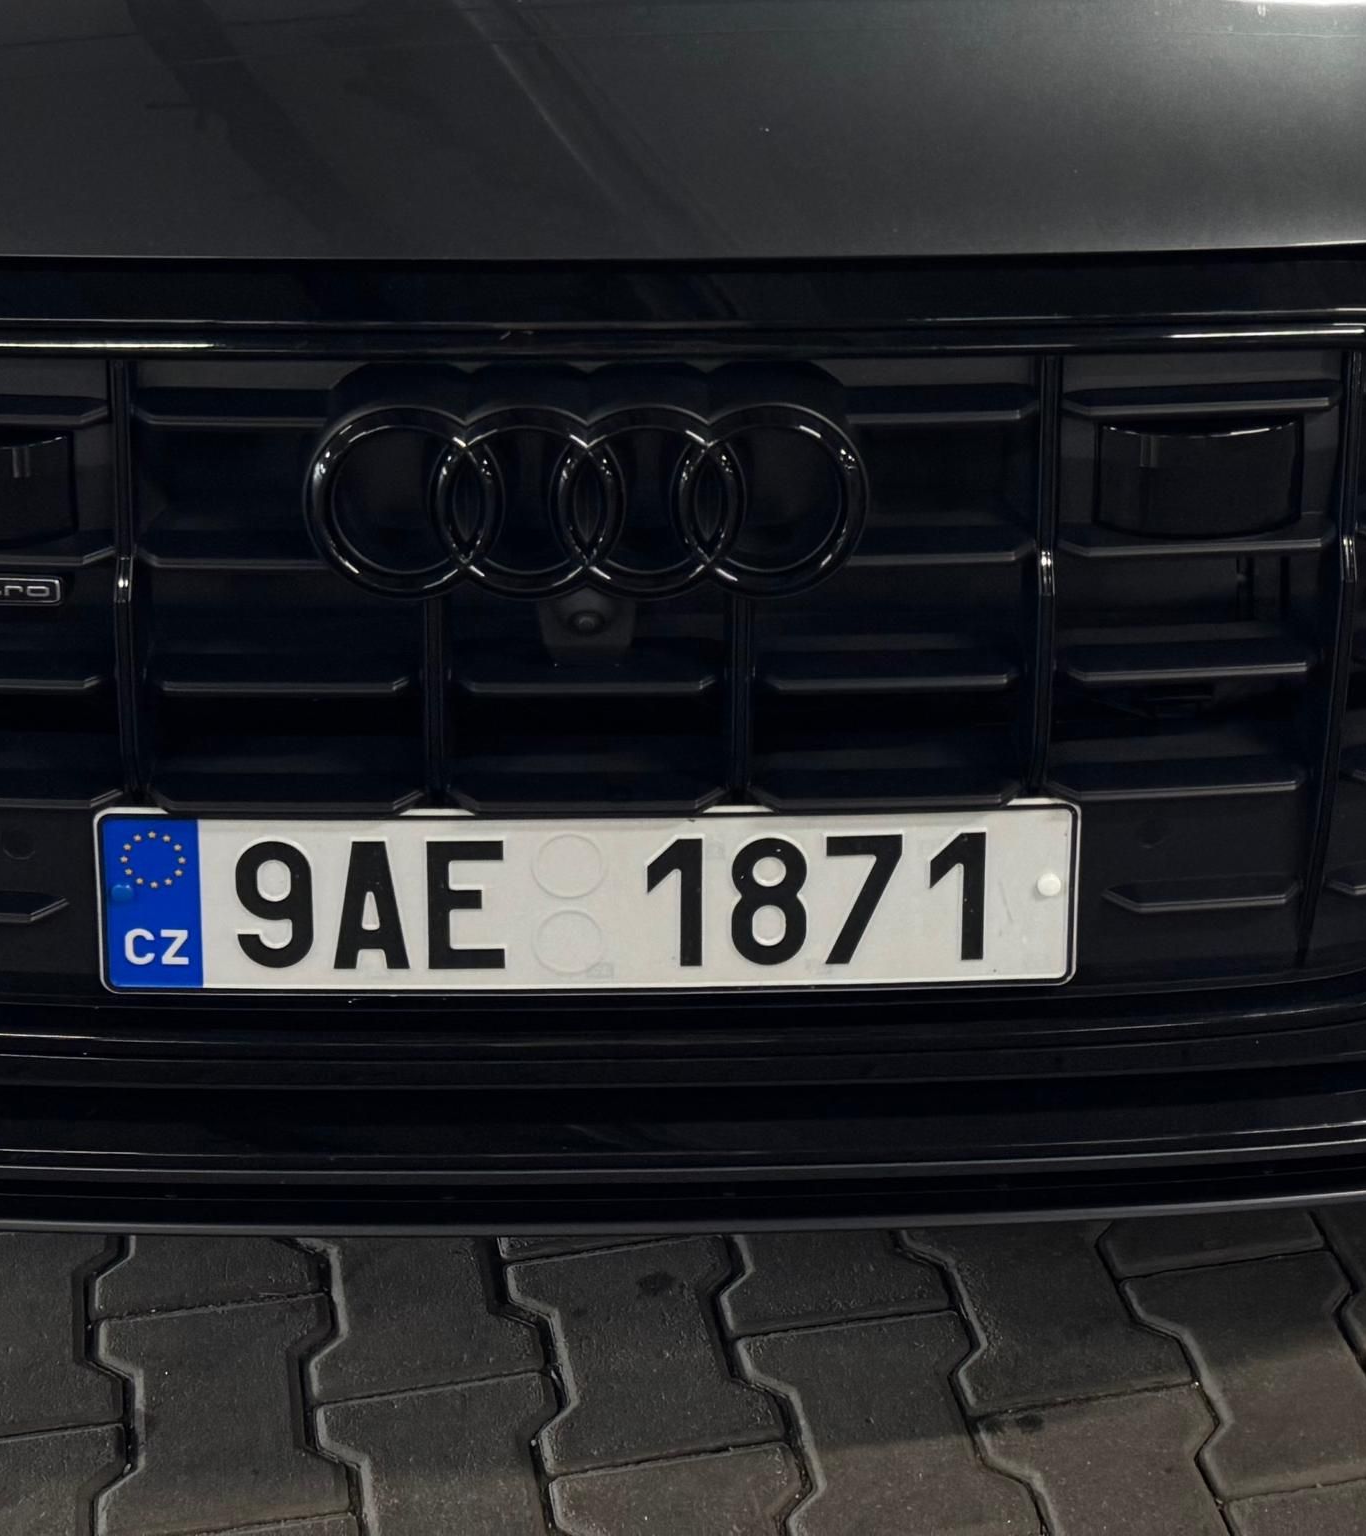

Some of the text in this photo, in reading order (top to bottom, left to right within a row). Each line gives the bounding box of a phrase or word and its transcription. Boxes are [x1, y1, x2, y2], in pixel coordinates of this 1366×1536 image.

[236, 830, 988, 971] 9AE 1871
[124, 928, 190, 968] CZ
